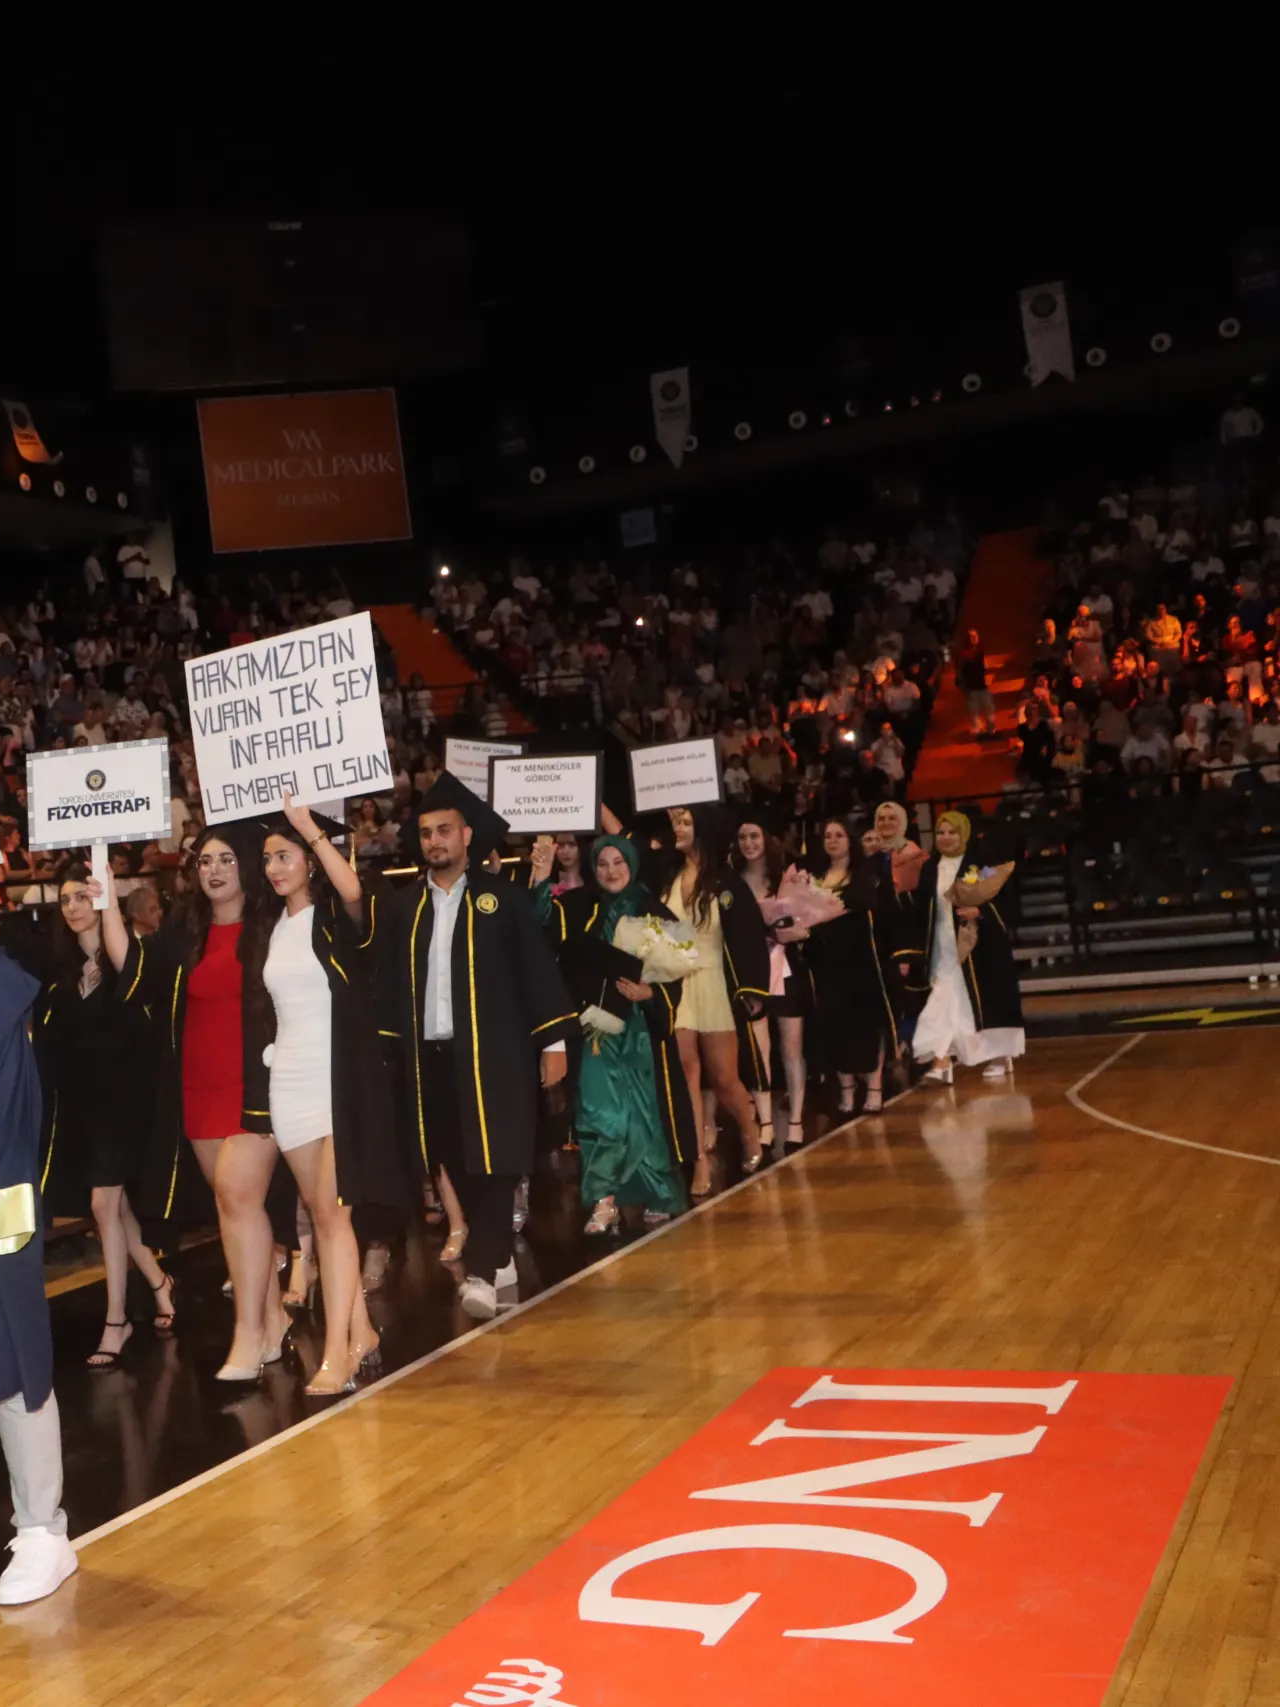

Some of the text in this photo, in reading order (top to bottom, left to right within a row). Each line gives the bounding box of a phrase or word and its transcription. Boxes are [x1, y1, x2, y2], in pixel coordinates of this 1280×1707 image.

[191, 628, 356, 701] ARKAMIZDAN
[194, 665, 373, 737] VURAN TEK ŞEY
[58, 794, 85, 805] TOROS
[206, 750, 390, 813] LAMBASI OLSUN
[525, 772, 562, 783] GÖRDÜK
[501, 808, 522, 816] AMA
[524, 807, 546, 816] HALA
[579, 1374, 1079, 1647] ING
